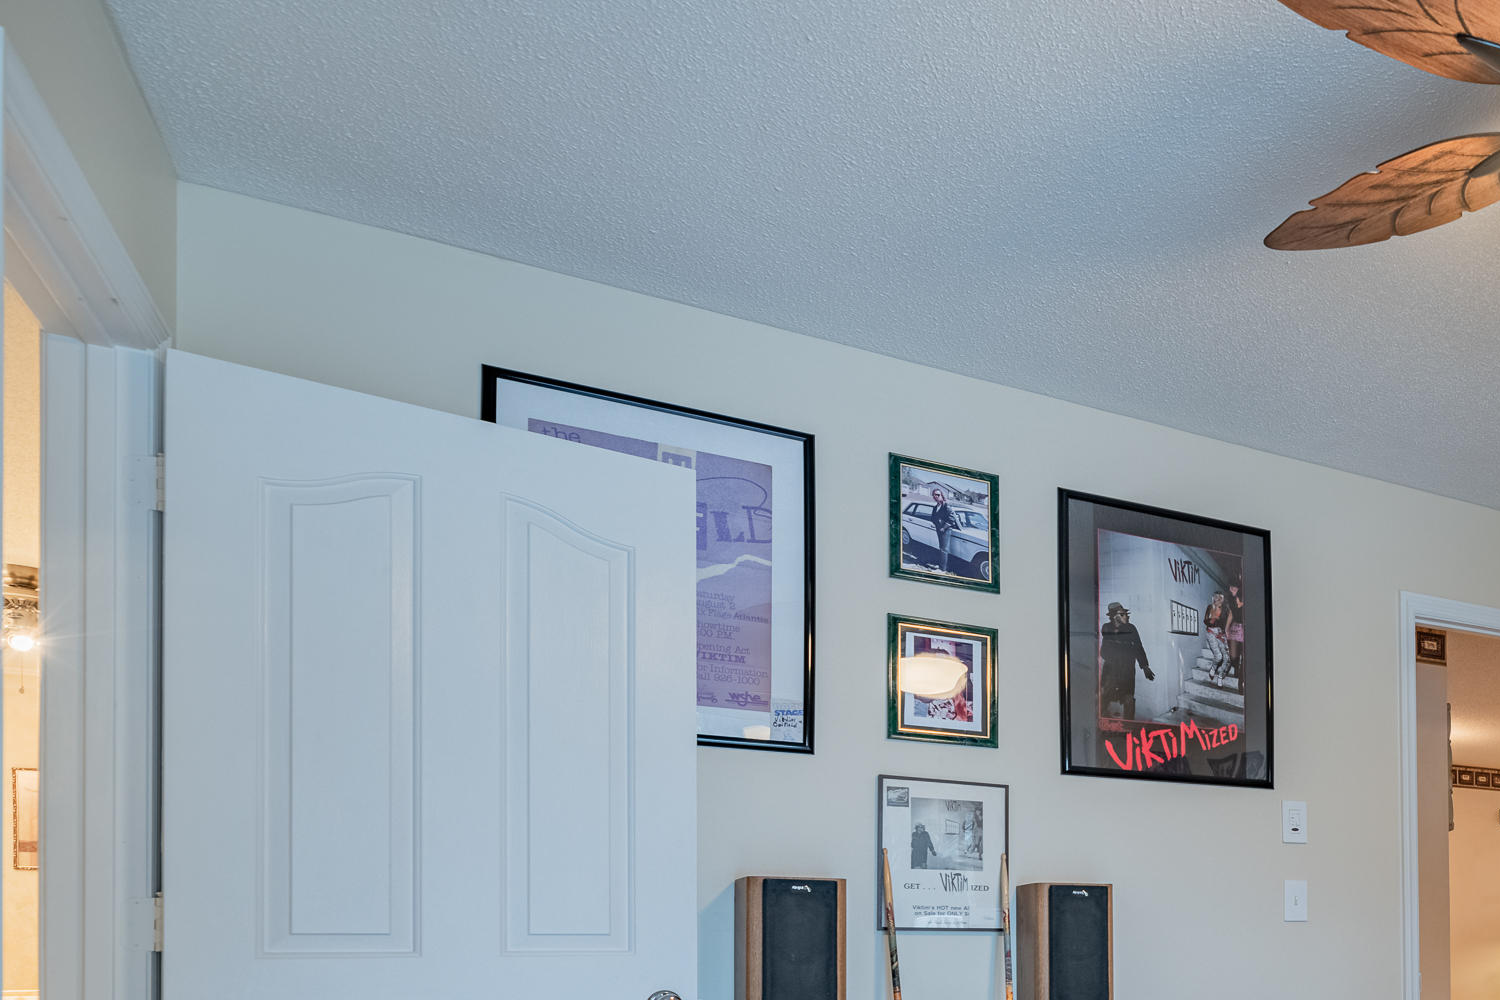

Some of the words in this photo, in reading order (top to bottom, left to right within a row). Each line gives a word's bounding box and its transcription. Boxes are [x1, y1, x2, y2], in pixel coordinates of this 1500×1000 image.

[697, 621, 740, 632] howtime
[697, 642, 731, 654] pening
[710, 664, 769, 678] Information
